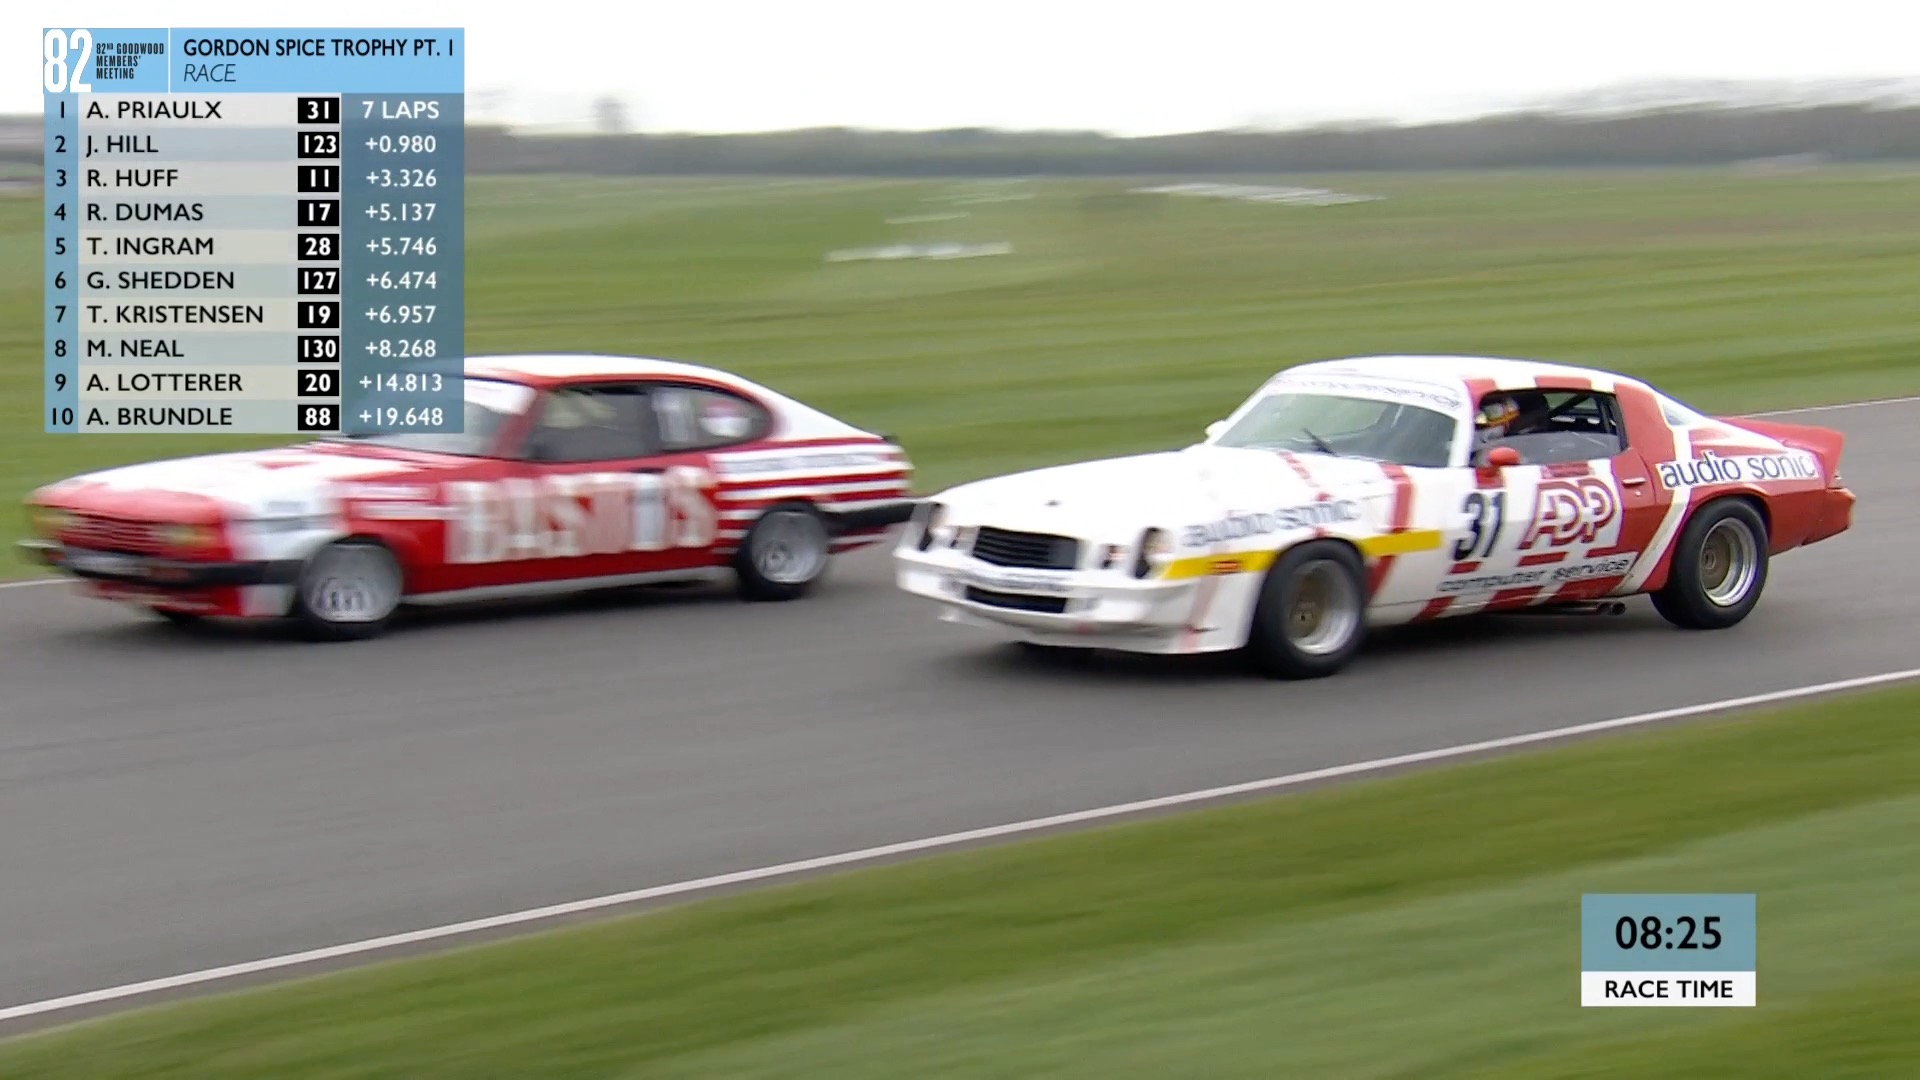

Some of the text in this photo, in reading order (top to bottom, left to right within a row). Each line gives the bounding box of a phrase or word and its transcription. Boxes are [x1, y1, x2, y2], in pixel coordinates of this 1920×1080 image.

[1660, 451, 1816, 489] audio sonic
[1453, 491, 1506, 560] 31
[1517, 477, 1615, 549] ADP
[1550, 558, 1630, 582] service
